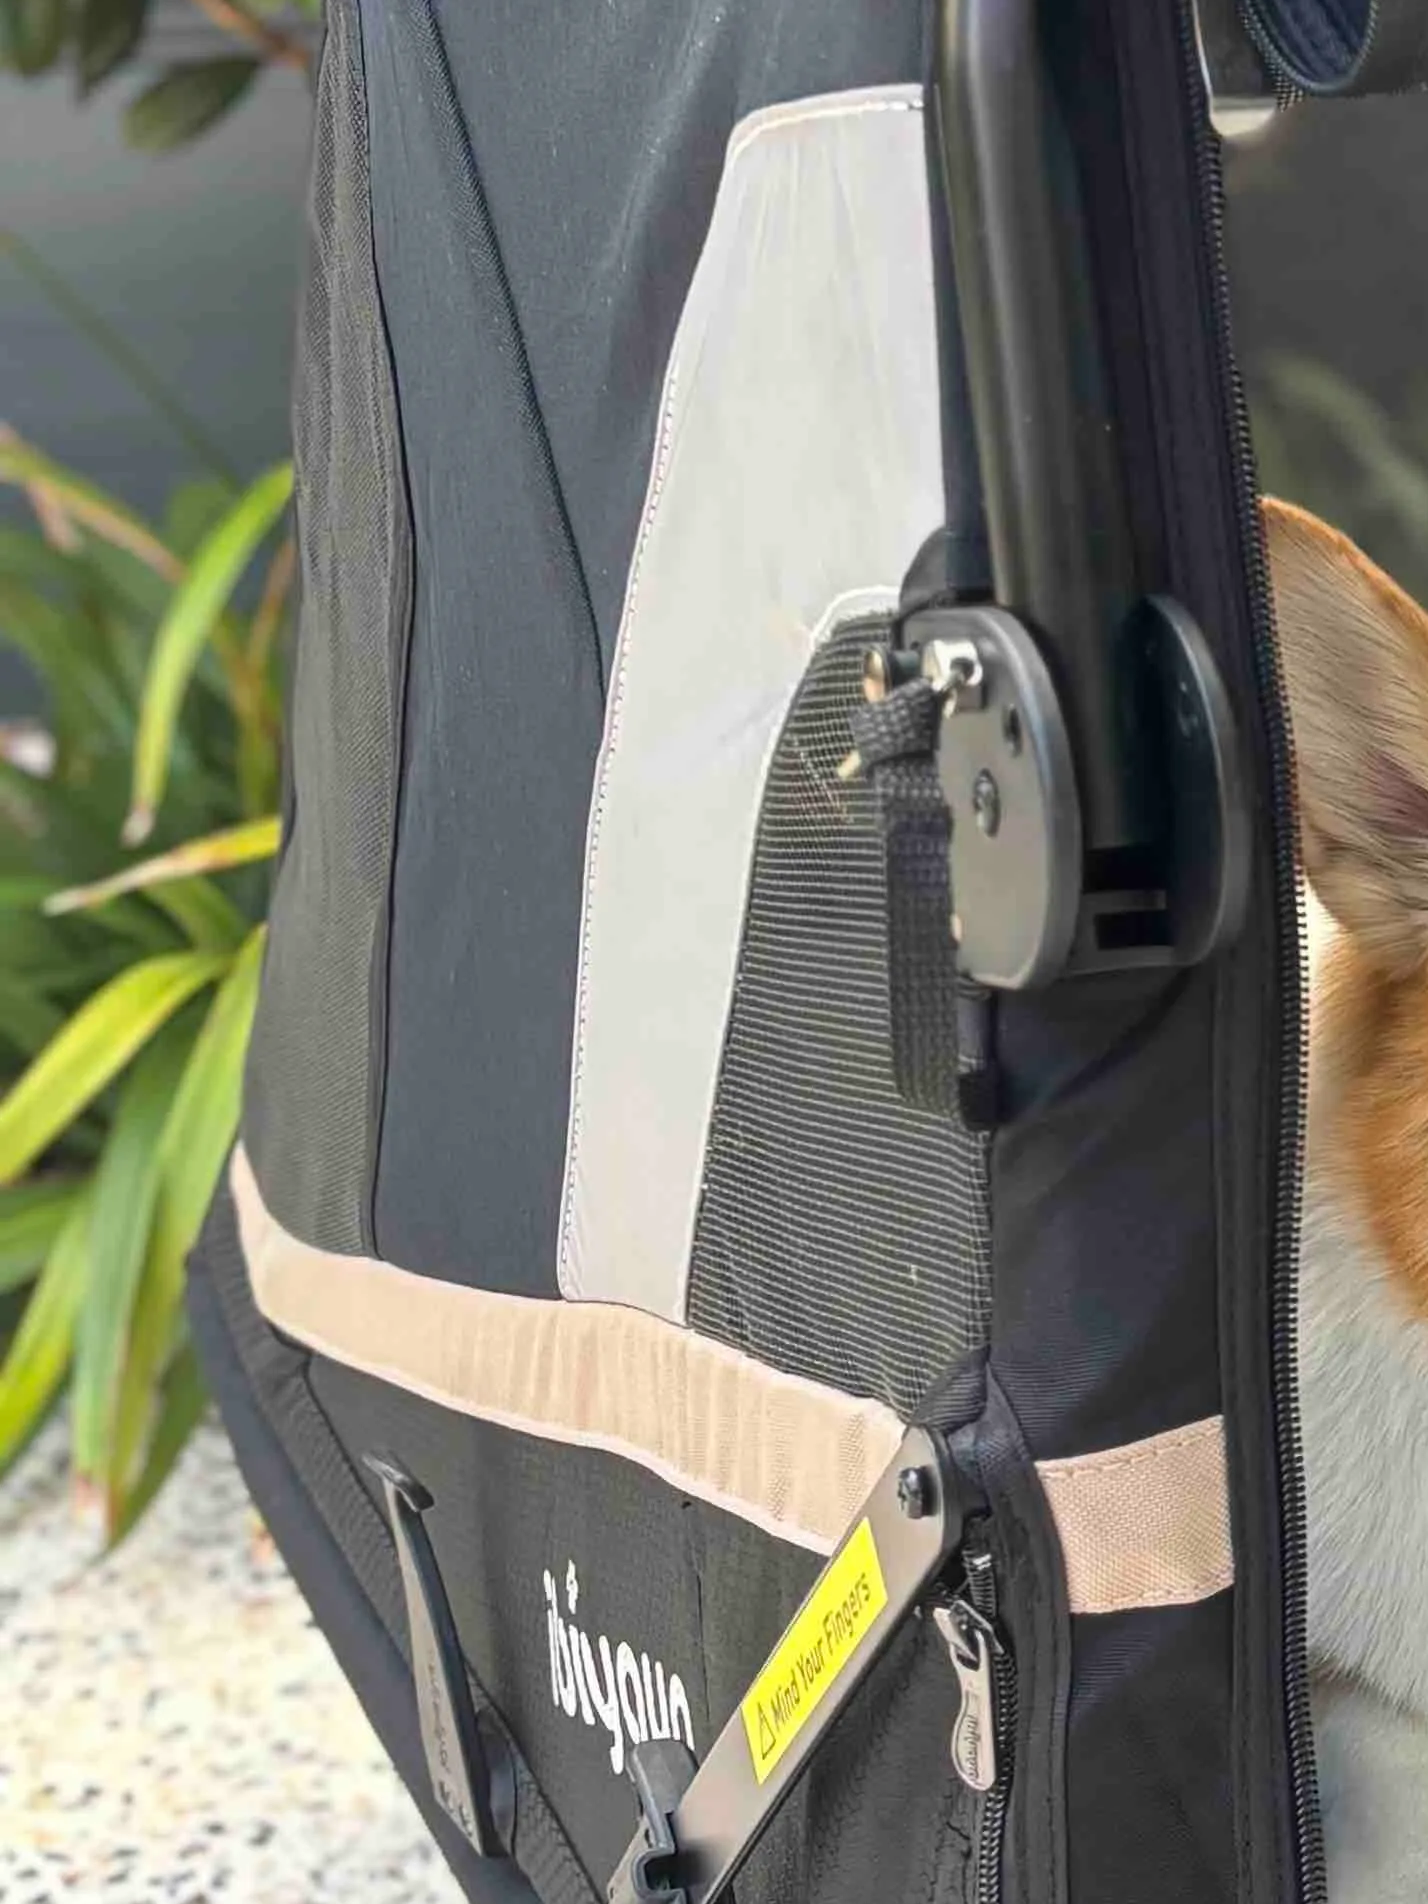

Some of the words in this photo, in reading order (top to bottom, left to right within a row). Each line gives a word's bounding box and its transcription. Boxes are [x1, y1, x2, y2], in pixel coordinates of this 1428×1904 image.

[770, 1669, 802, 1734] Mind
[797, 1637, 825, 1688] Your
[822, 1572, 871, 1654] Fingers
